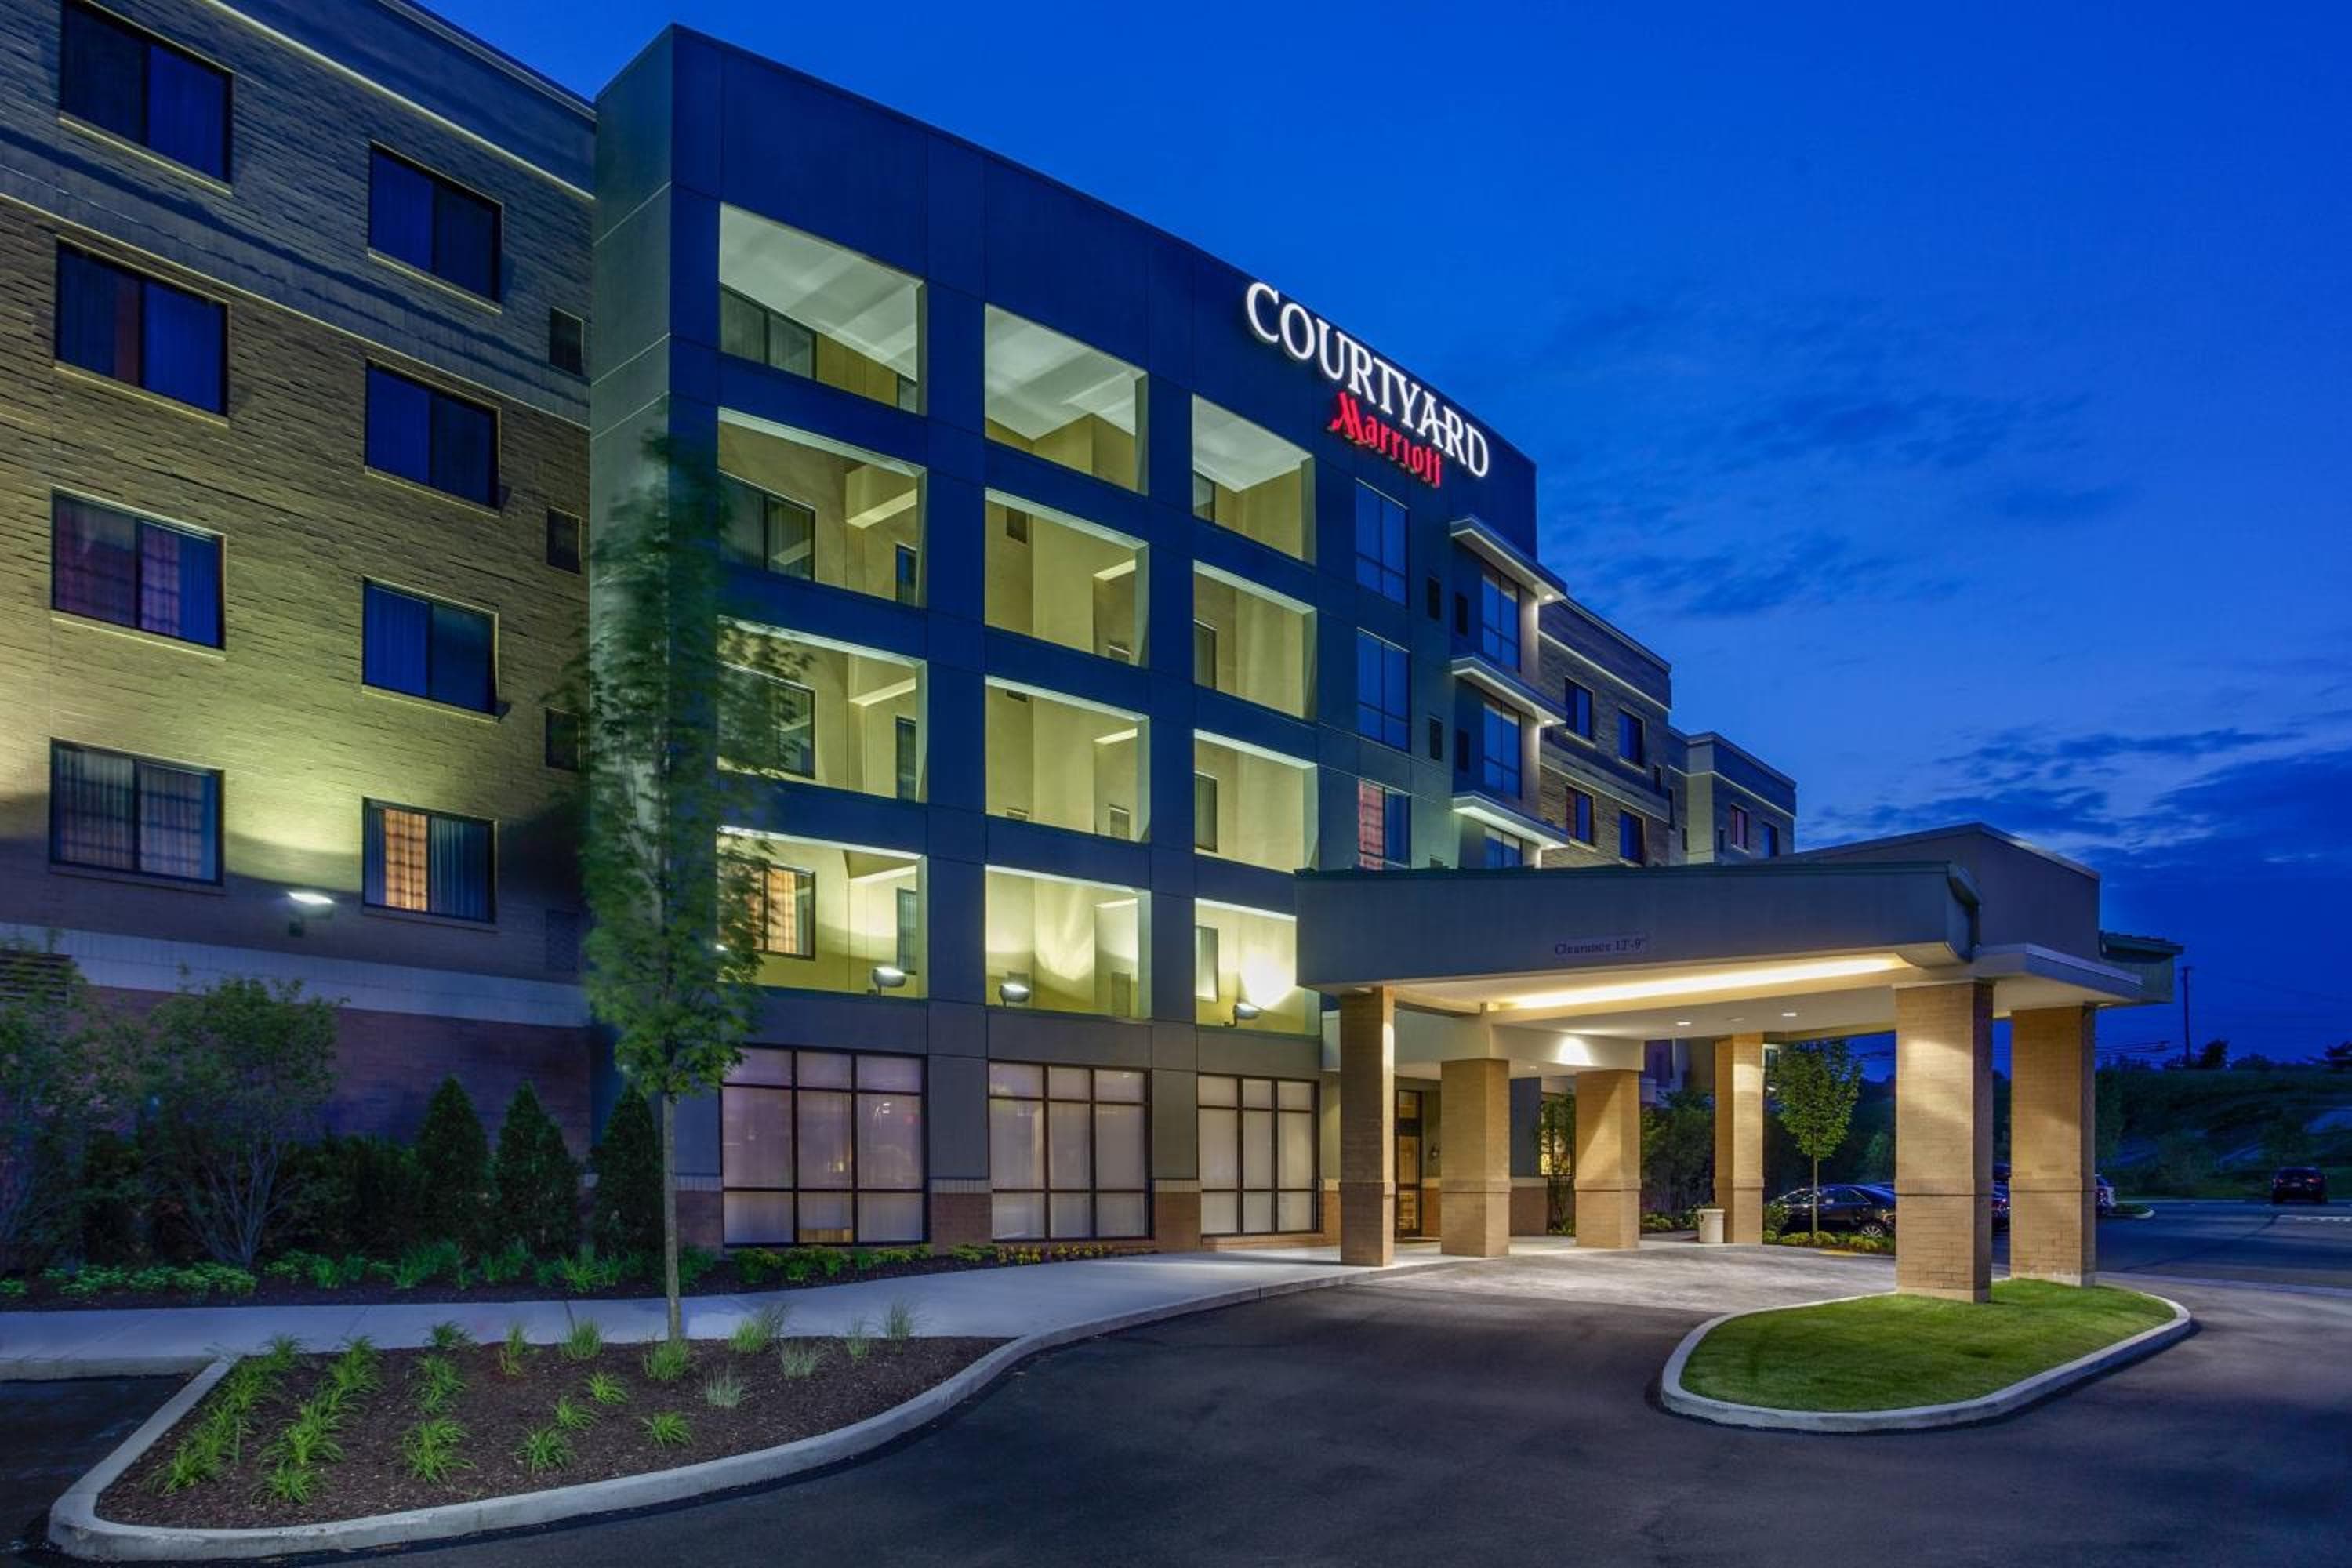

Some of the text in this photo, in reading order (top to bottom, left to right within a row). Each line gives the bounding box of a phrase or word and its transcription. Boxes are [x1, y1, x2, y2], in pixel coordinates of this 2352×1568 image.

[1246, 281, 1489, 477] COURTYARD
[1328, 391, 1442, 488] Marriott
[1555, 942, 1611, 955] Clearance
